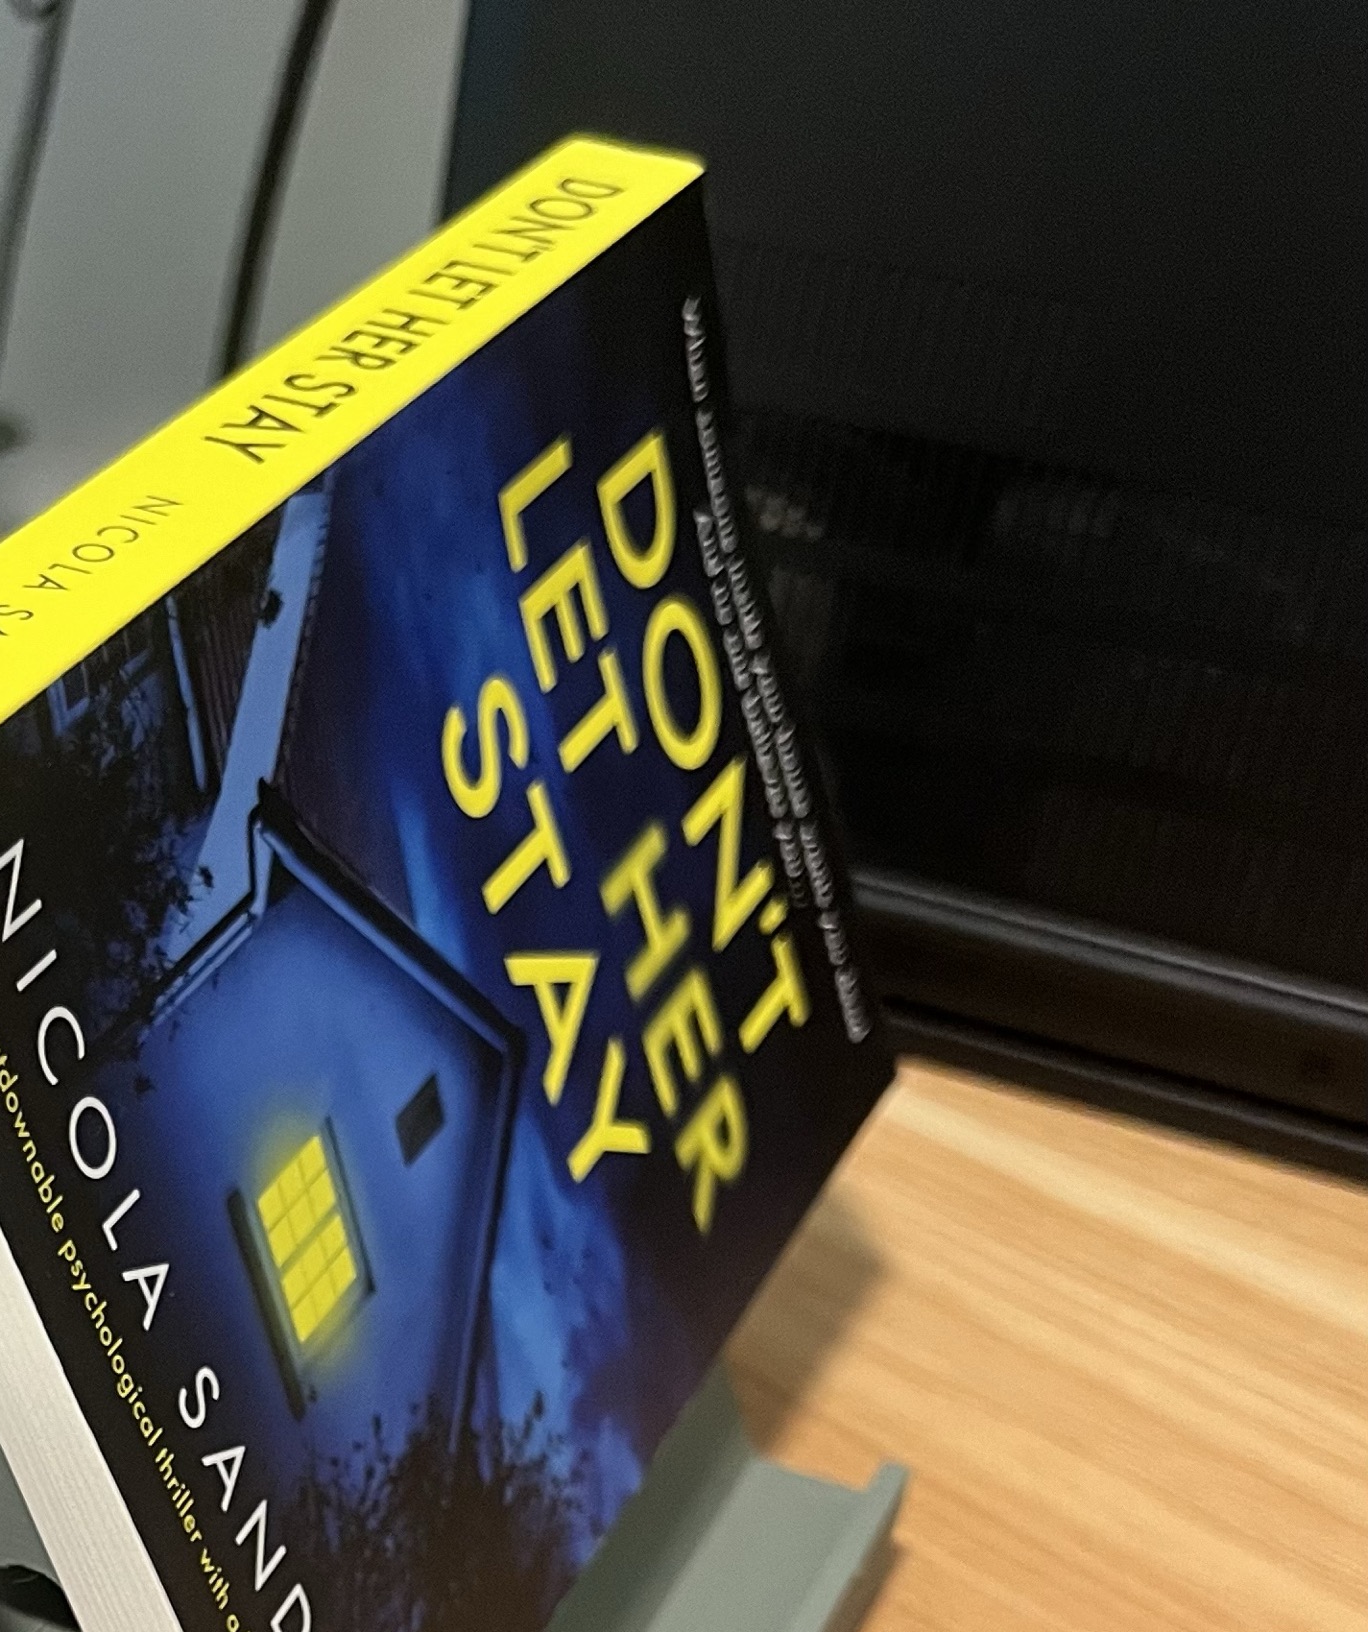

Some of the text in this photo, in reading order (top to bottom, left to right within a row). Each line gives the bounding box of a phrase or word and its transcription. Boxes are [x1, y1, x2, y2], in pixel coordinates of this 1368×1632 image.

[472, 177, 625, 264] DON'T
[408, 258, 519, 311] LET
[314, 307, 451, 371] HER
[203, 372, 358, 465] STAY
[22, 495, 184, 592] NICOLA
[596, 431, 809, 1053] DON'T
[498, 436, 748, 1234] LET HER
[442, 677, 651, 1182] STAY
[57, 1238, 164, 1448] psychological
[155, 1446, 203, 1545] thriller
[200, 1546, 231, 1611] with
